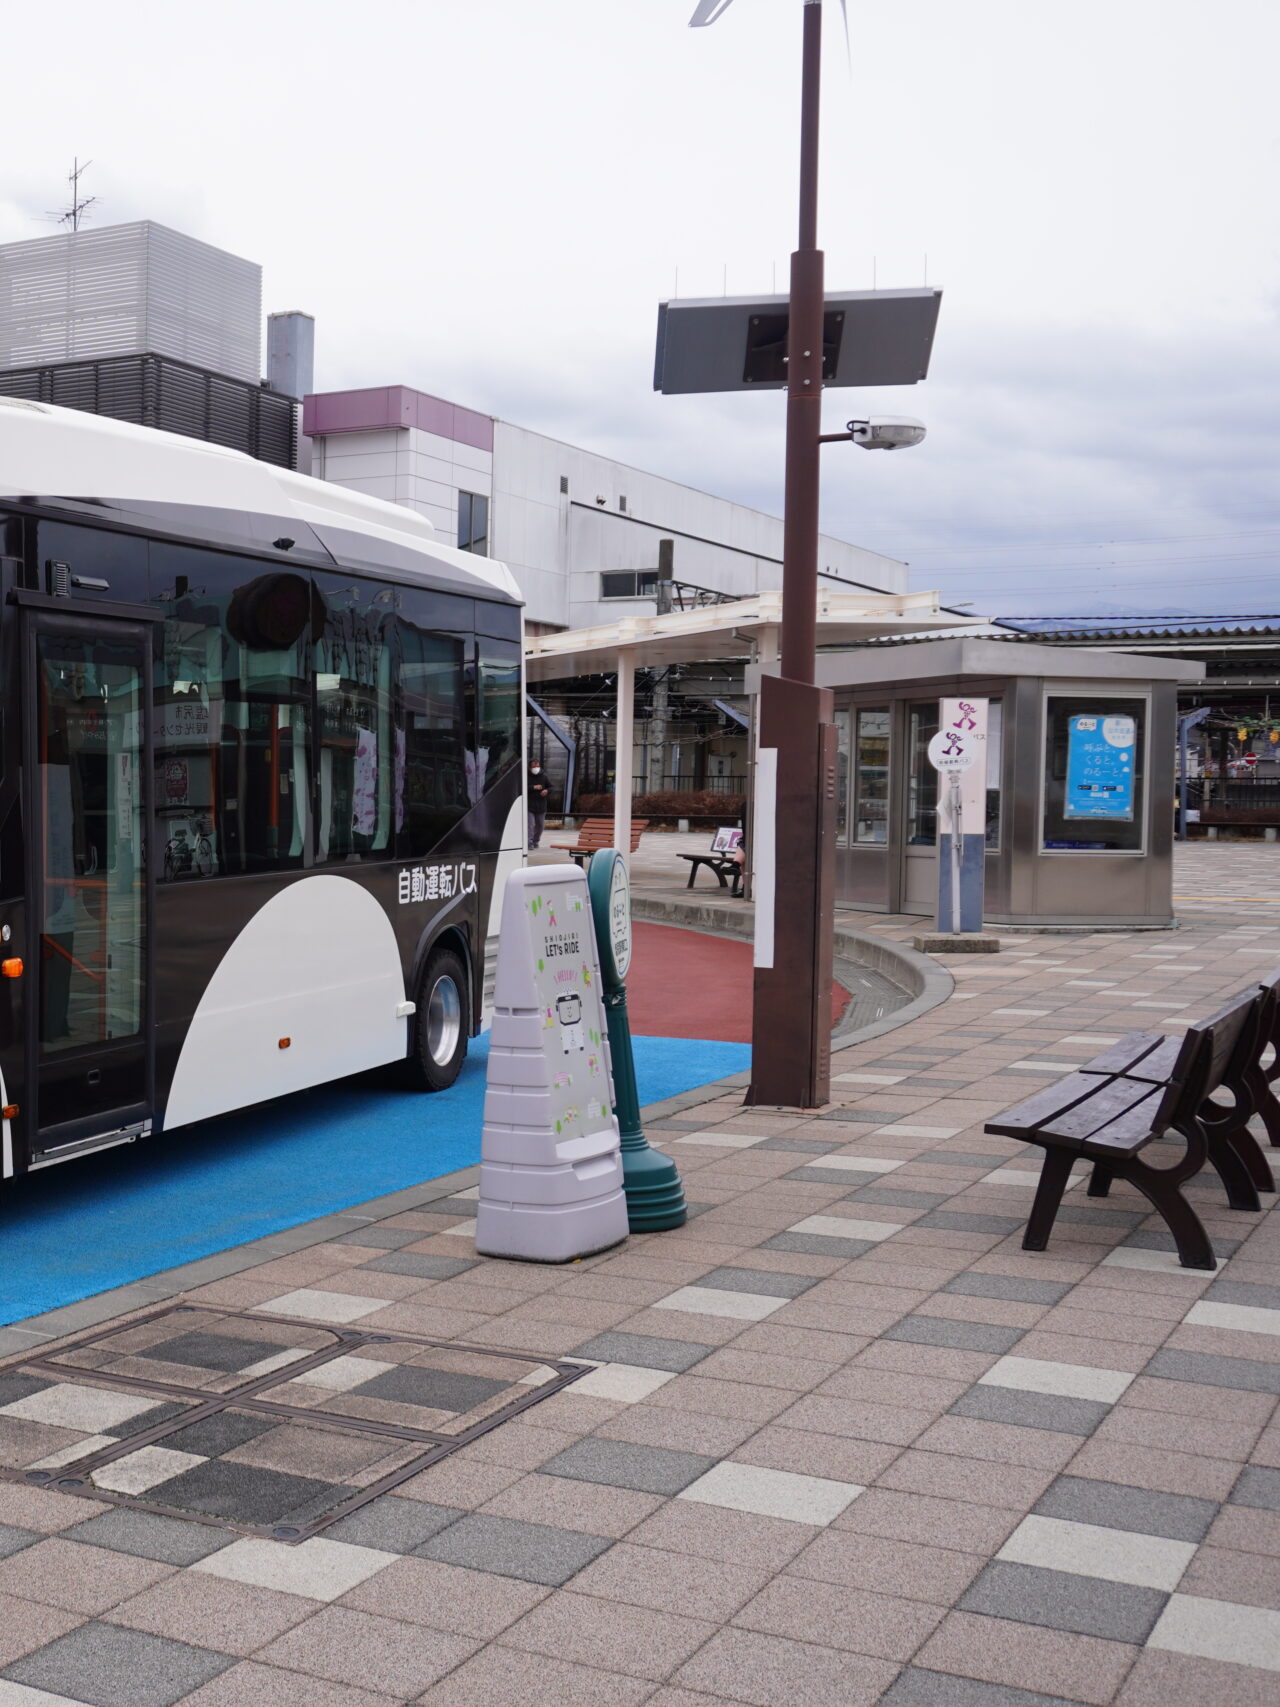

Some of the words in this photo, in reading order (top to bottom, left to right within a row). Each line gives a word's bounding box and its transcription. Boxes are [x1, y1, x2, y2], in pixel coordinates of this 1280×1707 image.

[398, 862, 477, 904] 自動運転バス
[544, 932, 579, 943] SHIOJIRI
[545, 943, 563, 957] LET's
[564, 941, 580, 954] RIDE
